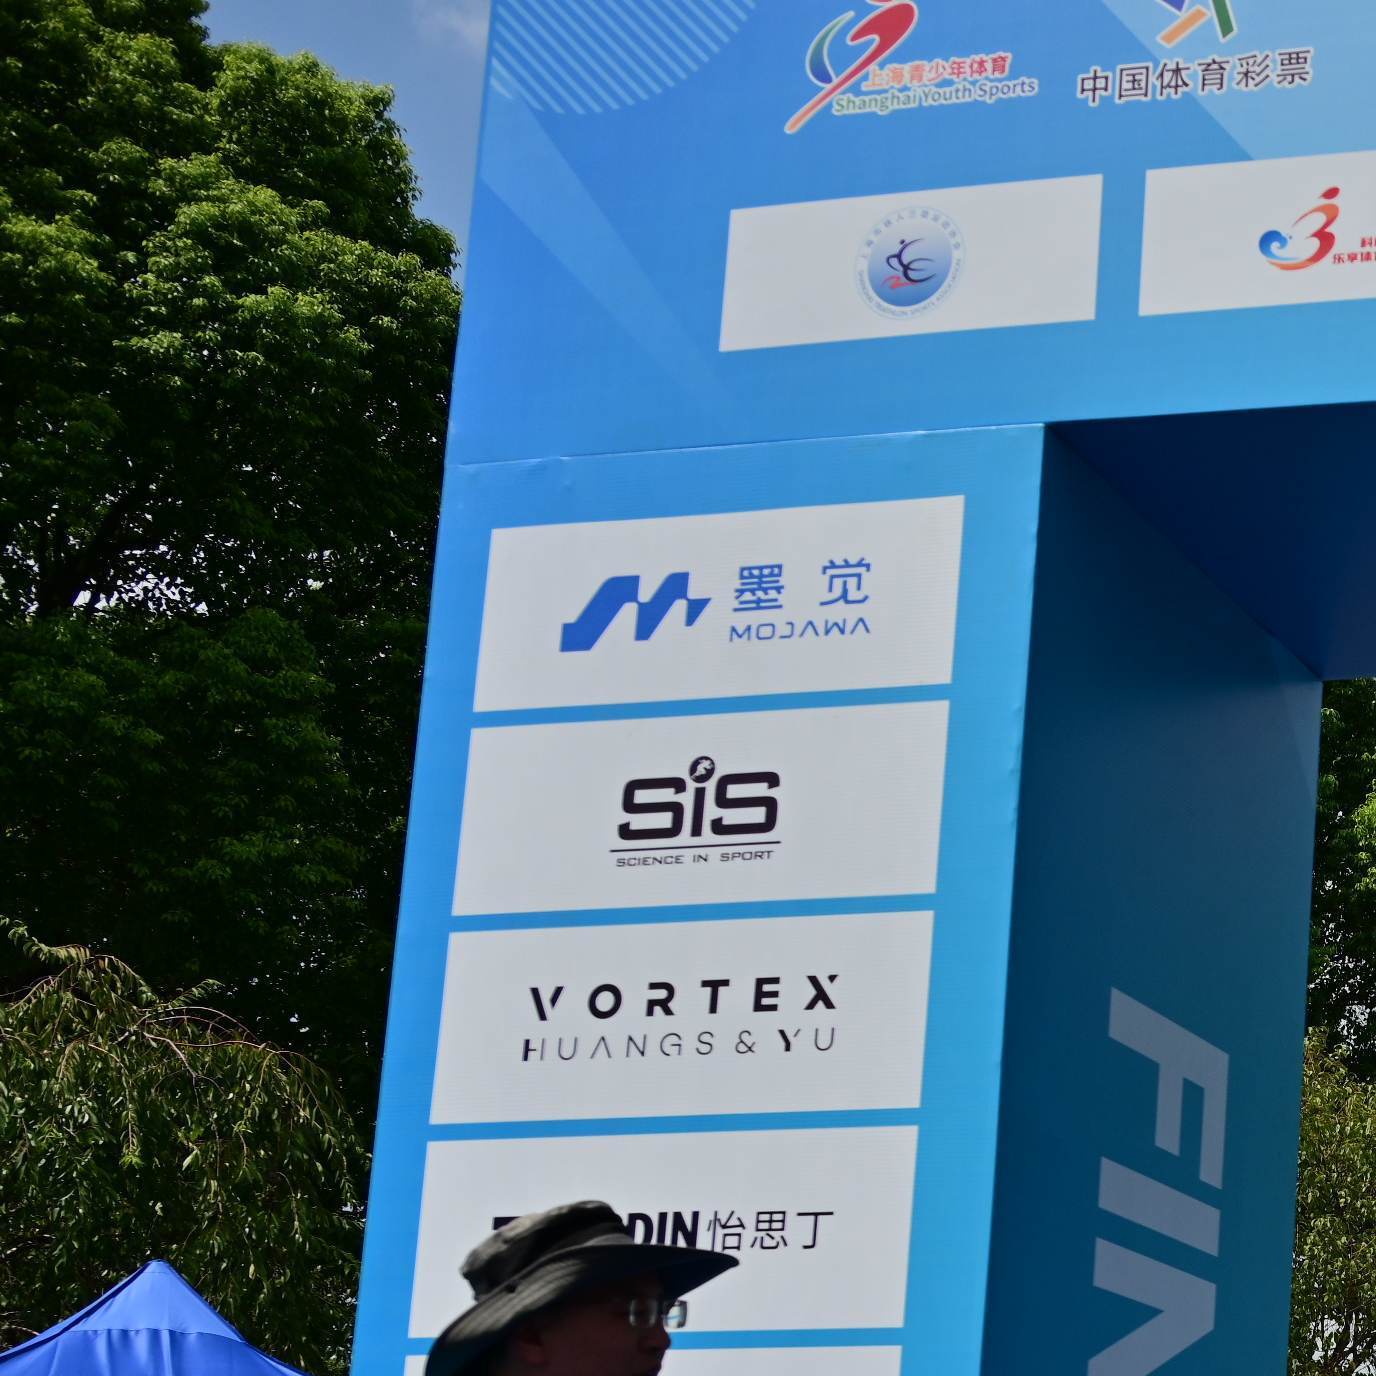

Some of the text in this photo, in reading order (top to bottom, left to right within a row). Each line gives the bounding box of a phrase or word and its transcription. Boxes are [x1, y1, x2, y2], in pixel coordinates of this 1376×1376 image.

[862, 54, 1010, 90] 上海青少年体育
[1078, 48, 1313, 105] 中国体育彩票
[834, 78, 1036, 114] Shanghai Youth Sports
[732, 557, 872, 613] 墨觉
[729, 617, 871, 642] MOJAWA
[616, 850, 775, 868] SCIENCE IN SPORT
[529, 974, 841, 1021] VORTEX
[521, 1028, 838, 1062] HUANGS & YU
[707, 1209, 834, 1251] 怡思丁
